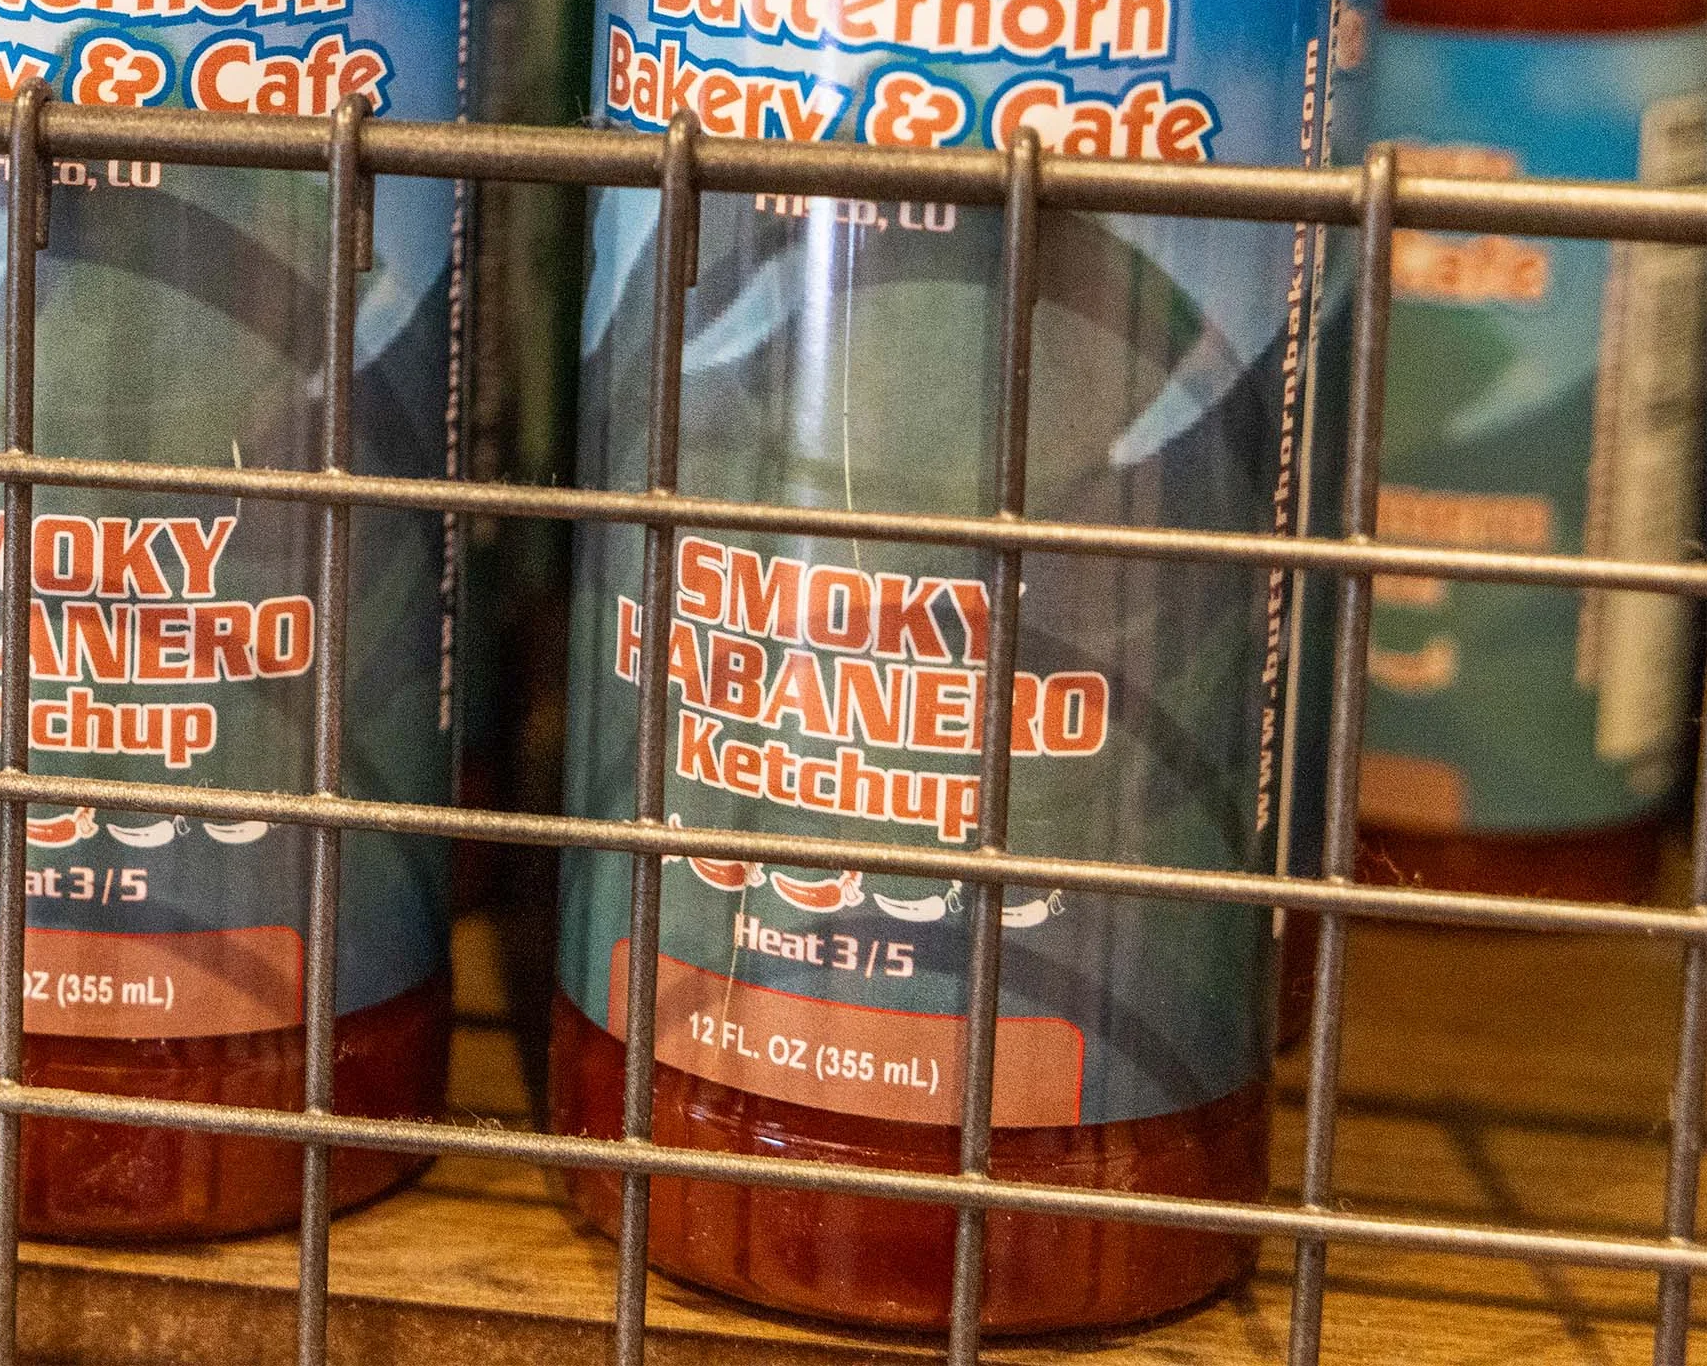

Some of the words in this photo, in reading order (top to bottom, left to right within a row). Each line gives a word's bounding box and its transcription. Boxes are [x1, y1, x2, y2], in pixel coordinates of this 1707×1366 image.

[70, 34, 166, 106] &
[190, 32, 386, 116] Cafe
[607, 26, 845, 142] Bakery
[864, 70, 967, 147] &
[991, 78, 1213, 162] Cafe
[1254, 37, 1320, 832] www.buttrhornbake.com
[676, 535, 1026, 664] SMOKY
[676, 709, 981, 844] Ketchup
[56, 973, 114, 1010] (355
[121, 975, 175, 1012] mL)
[732, 912, 825, 966] Heat
[688, 1010, 716, 1046] 12
[721, 1019, 760, 1060] FL.
[767, 1033, 808, 1071] OZ
[815, 1044, 875, 1081] (355
[883, 1056, 940, 1096] mL)
